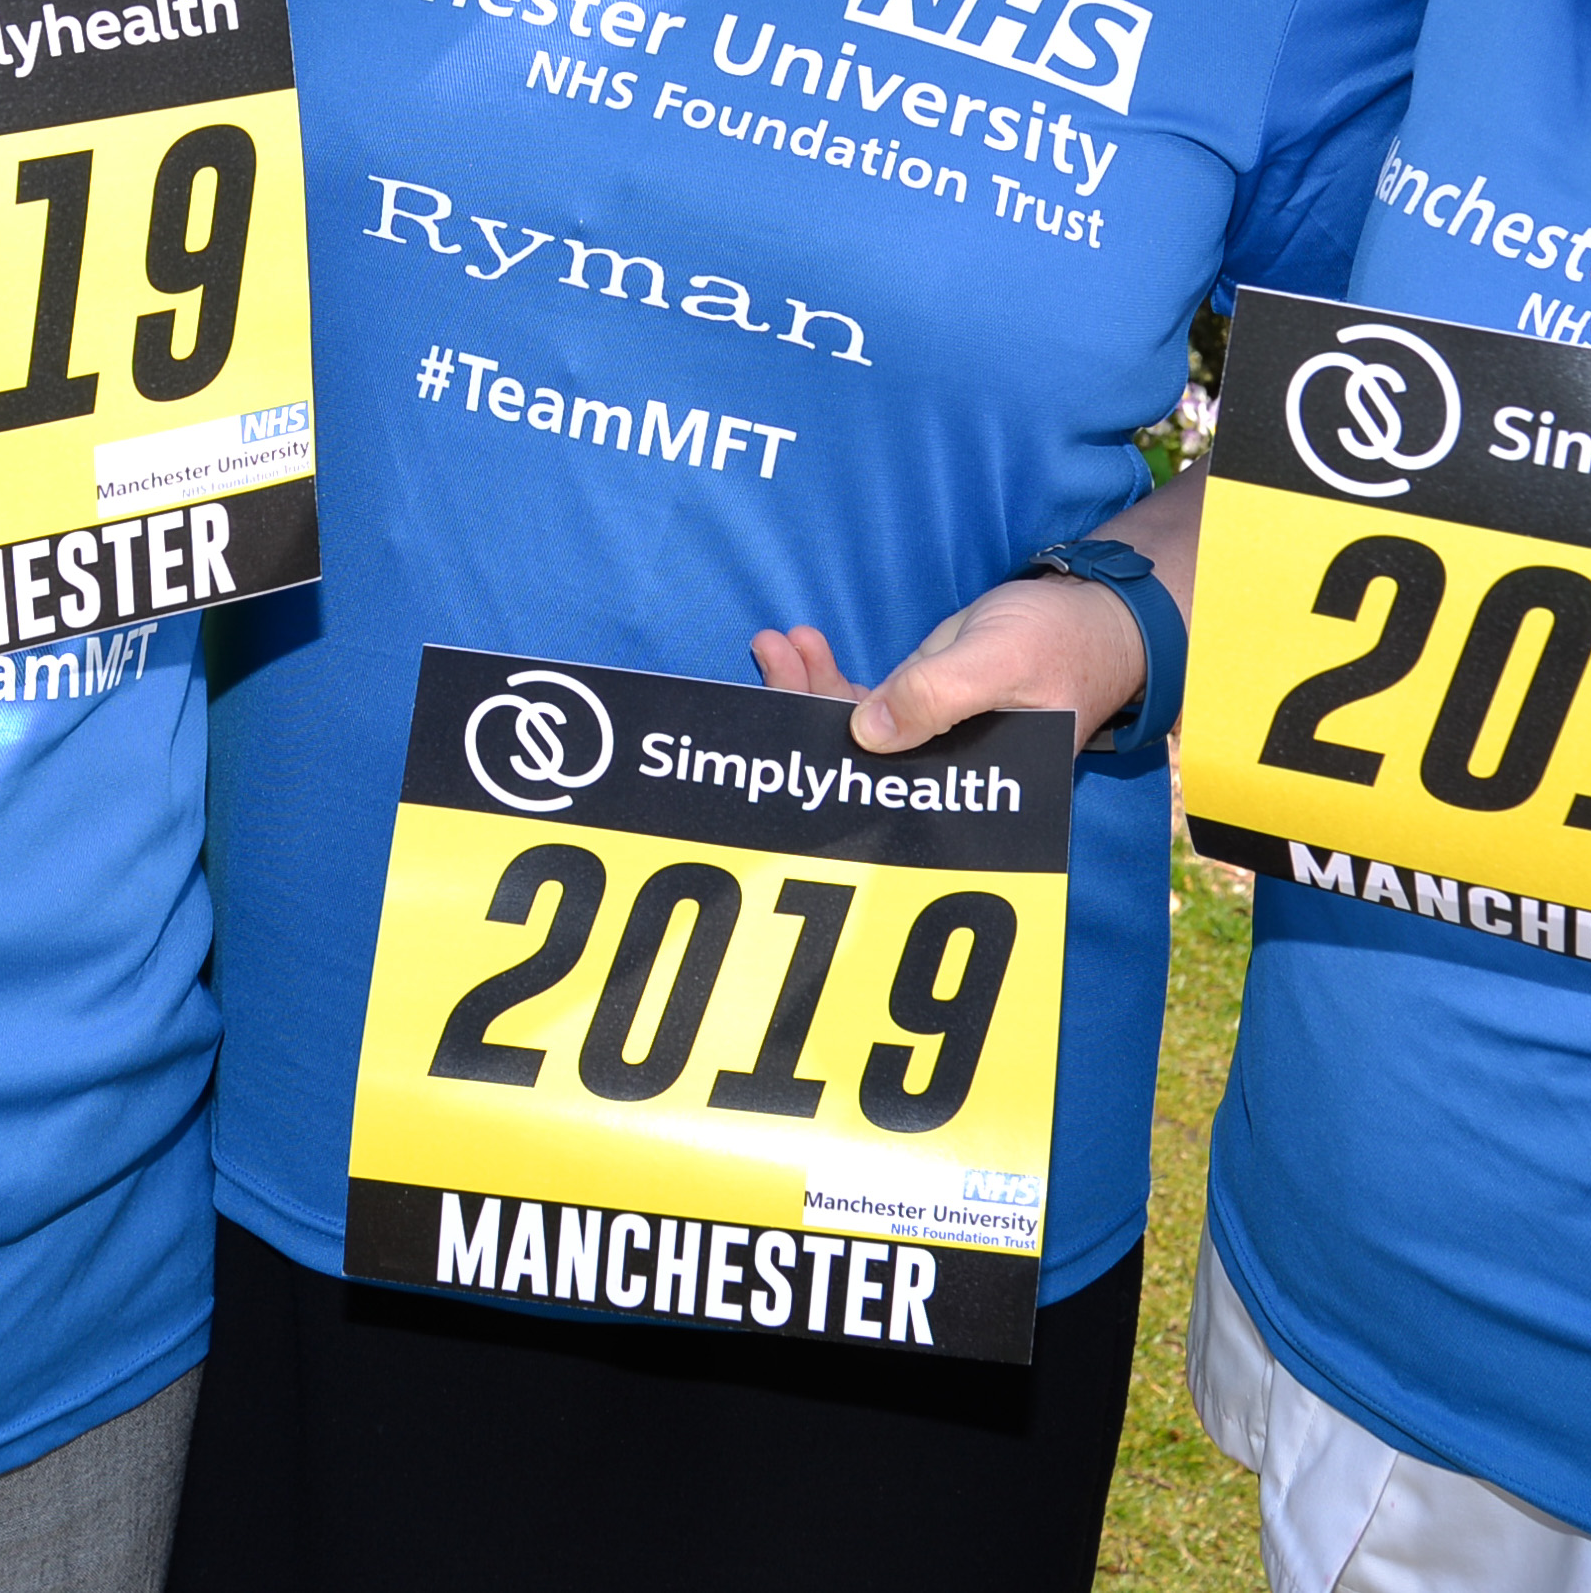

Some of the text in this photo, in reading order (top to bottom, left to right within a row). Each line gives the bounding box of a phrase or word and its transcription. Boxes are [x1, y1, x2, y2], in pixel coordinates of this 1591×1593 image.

[525, 50, 1107, 249] NHS Foundation Trust
[712, 12, 1120, 195] University
[362, 173, 873, 368] Ryman
[243, 402, 308, 444] NHS
[416, 344, 797, 479] #TeamMFT
[97, 441, 310, 501] Manchester University
[638, 732, 1022, 813] Simplyhealth
[427, 842, 1019, 1135] 2019
[803, 1190, 1039, 1237] Manchester University
[891, 1223, 1037, 1251] NHS Foundation Trust
[964, 1169, 1039, 1207] NHS
[436, 1192, 936, 1347] MANCHESTER
